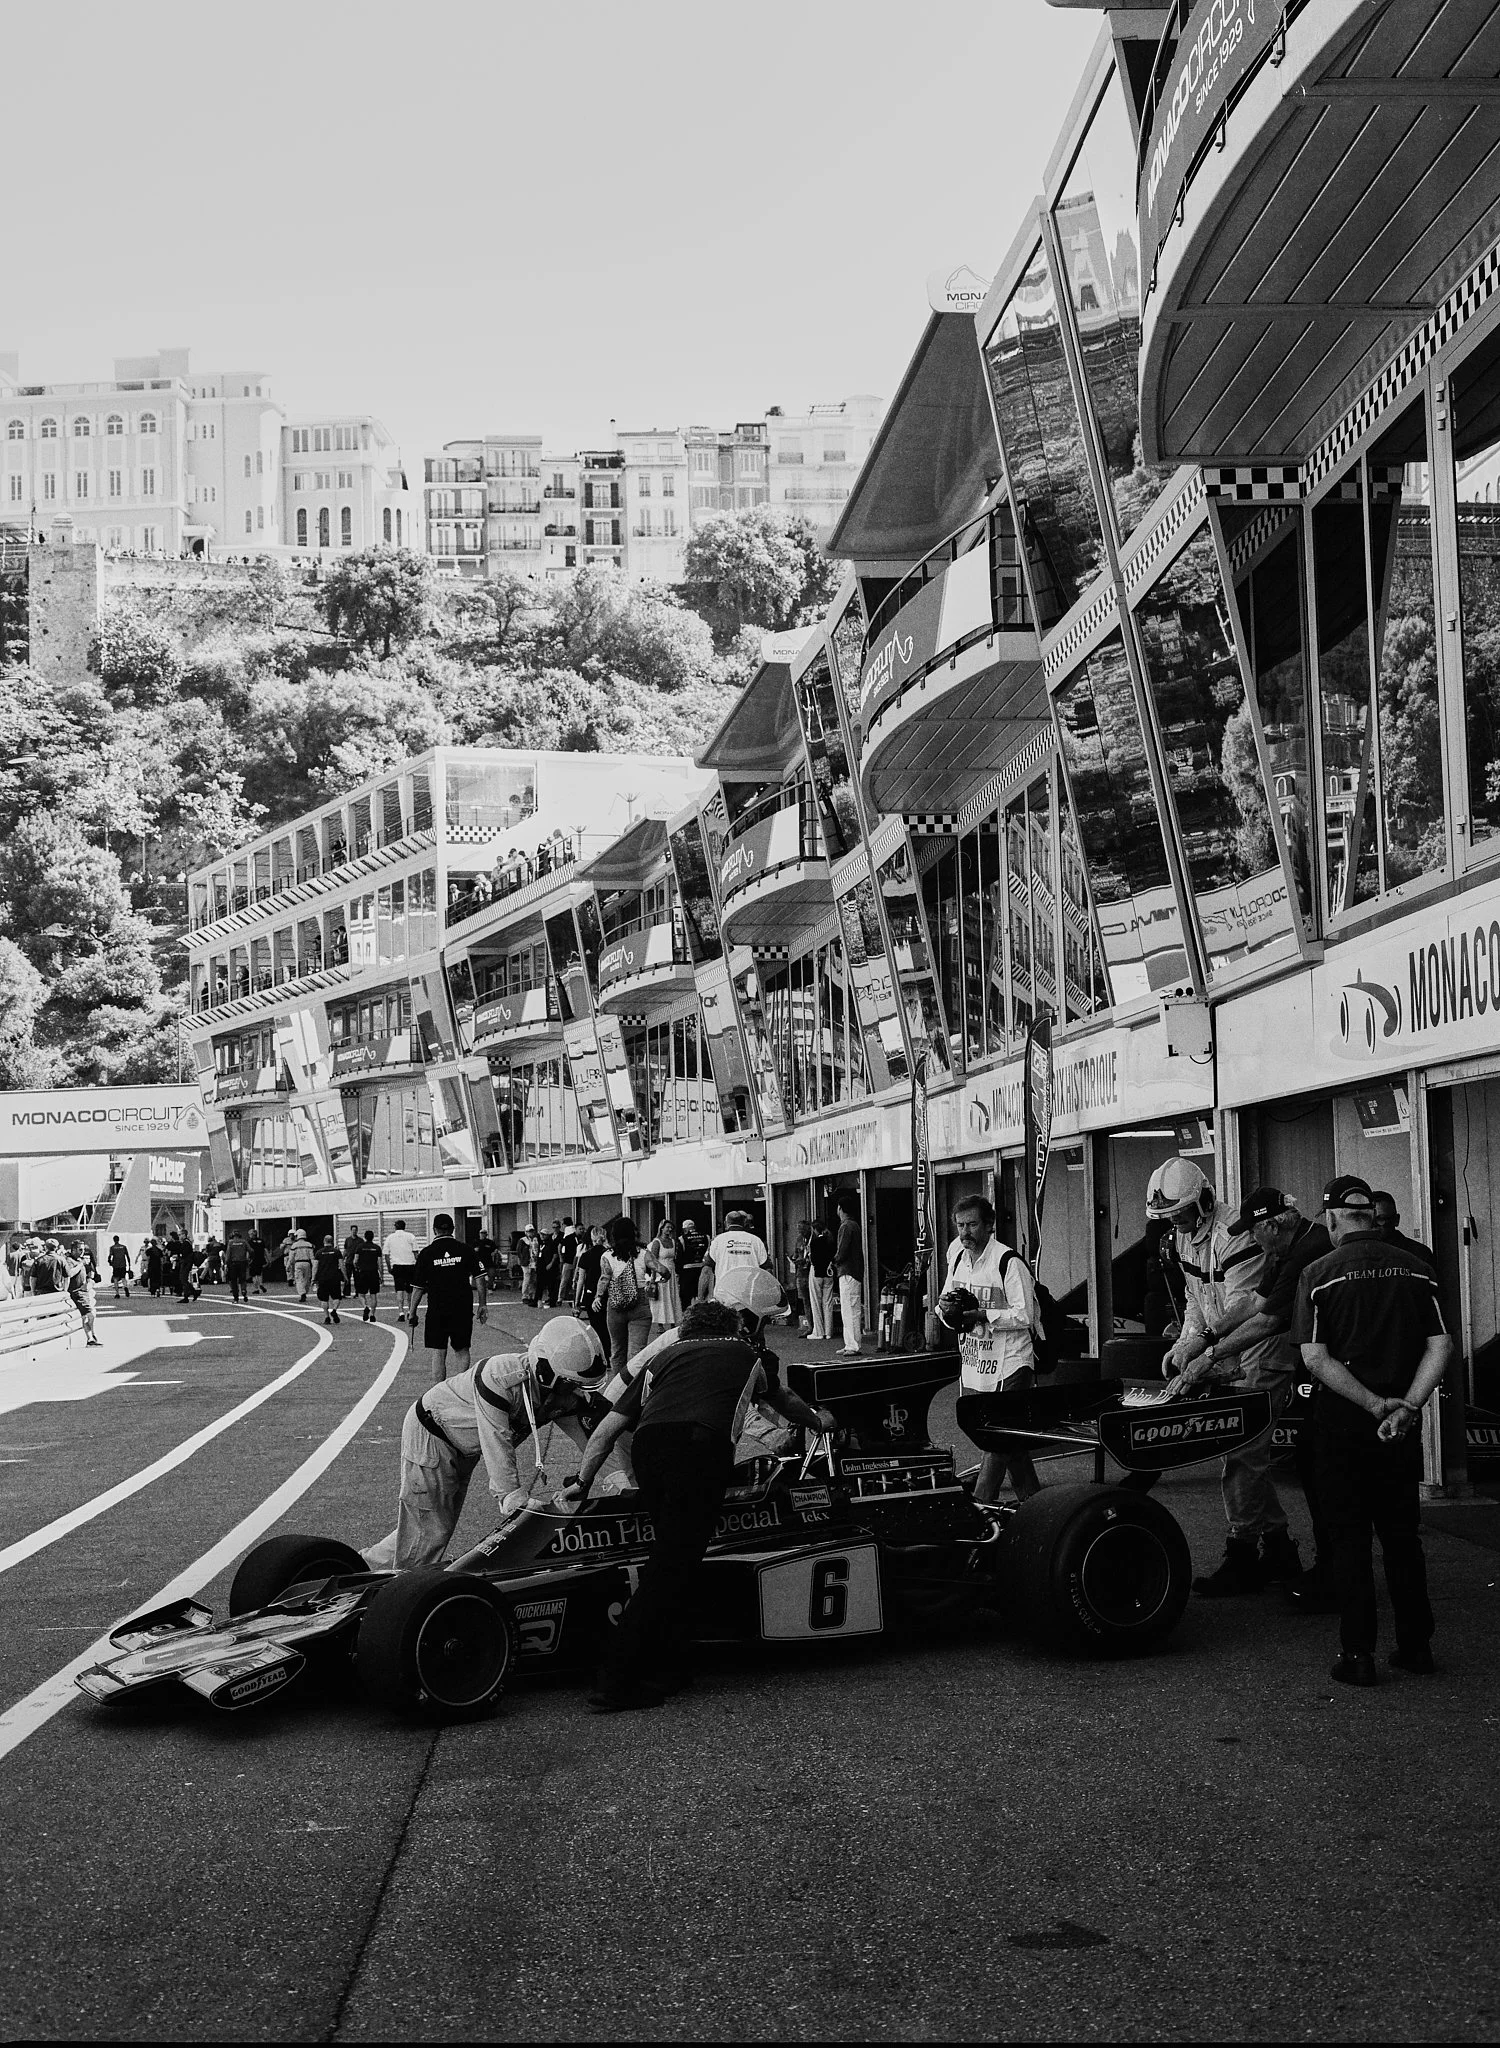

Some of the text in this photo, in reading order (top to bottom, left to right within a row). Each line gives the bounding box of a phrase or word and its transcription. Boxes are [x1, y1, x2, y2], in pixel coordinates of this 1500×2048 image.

[1195, 17, 1243, 115] SINCE 1929
[1408, 920, 1500, 1033] MONACO
[1066, 1050, 1118, 1114] HISTORIQUE
[12, 1105, 183, 1126] MONACOCIRCUIT
[114, 1122, 171, 1132] SINCE 1929
[1346, 1267, 1411, 1281] TEAM LOTUS
[793, 1494, 828, 1503] CHAMPION
[551, 1525, 612, 1554] John
[615, 1516, 657, 1546] Pla
[713, 1501, 782, 1538] pecial
[800, 1511, 831, 1524] Ickx
[809, 1557, 850, 1632] 6
